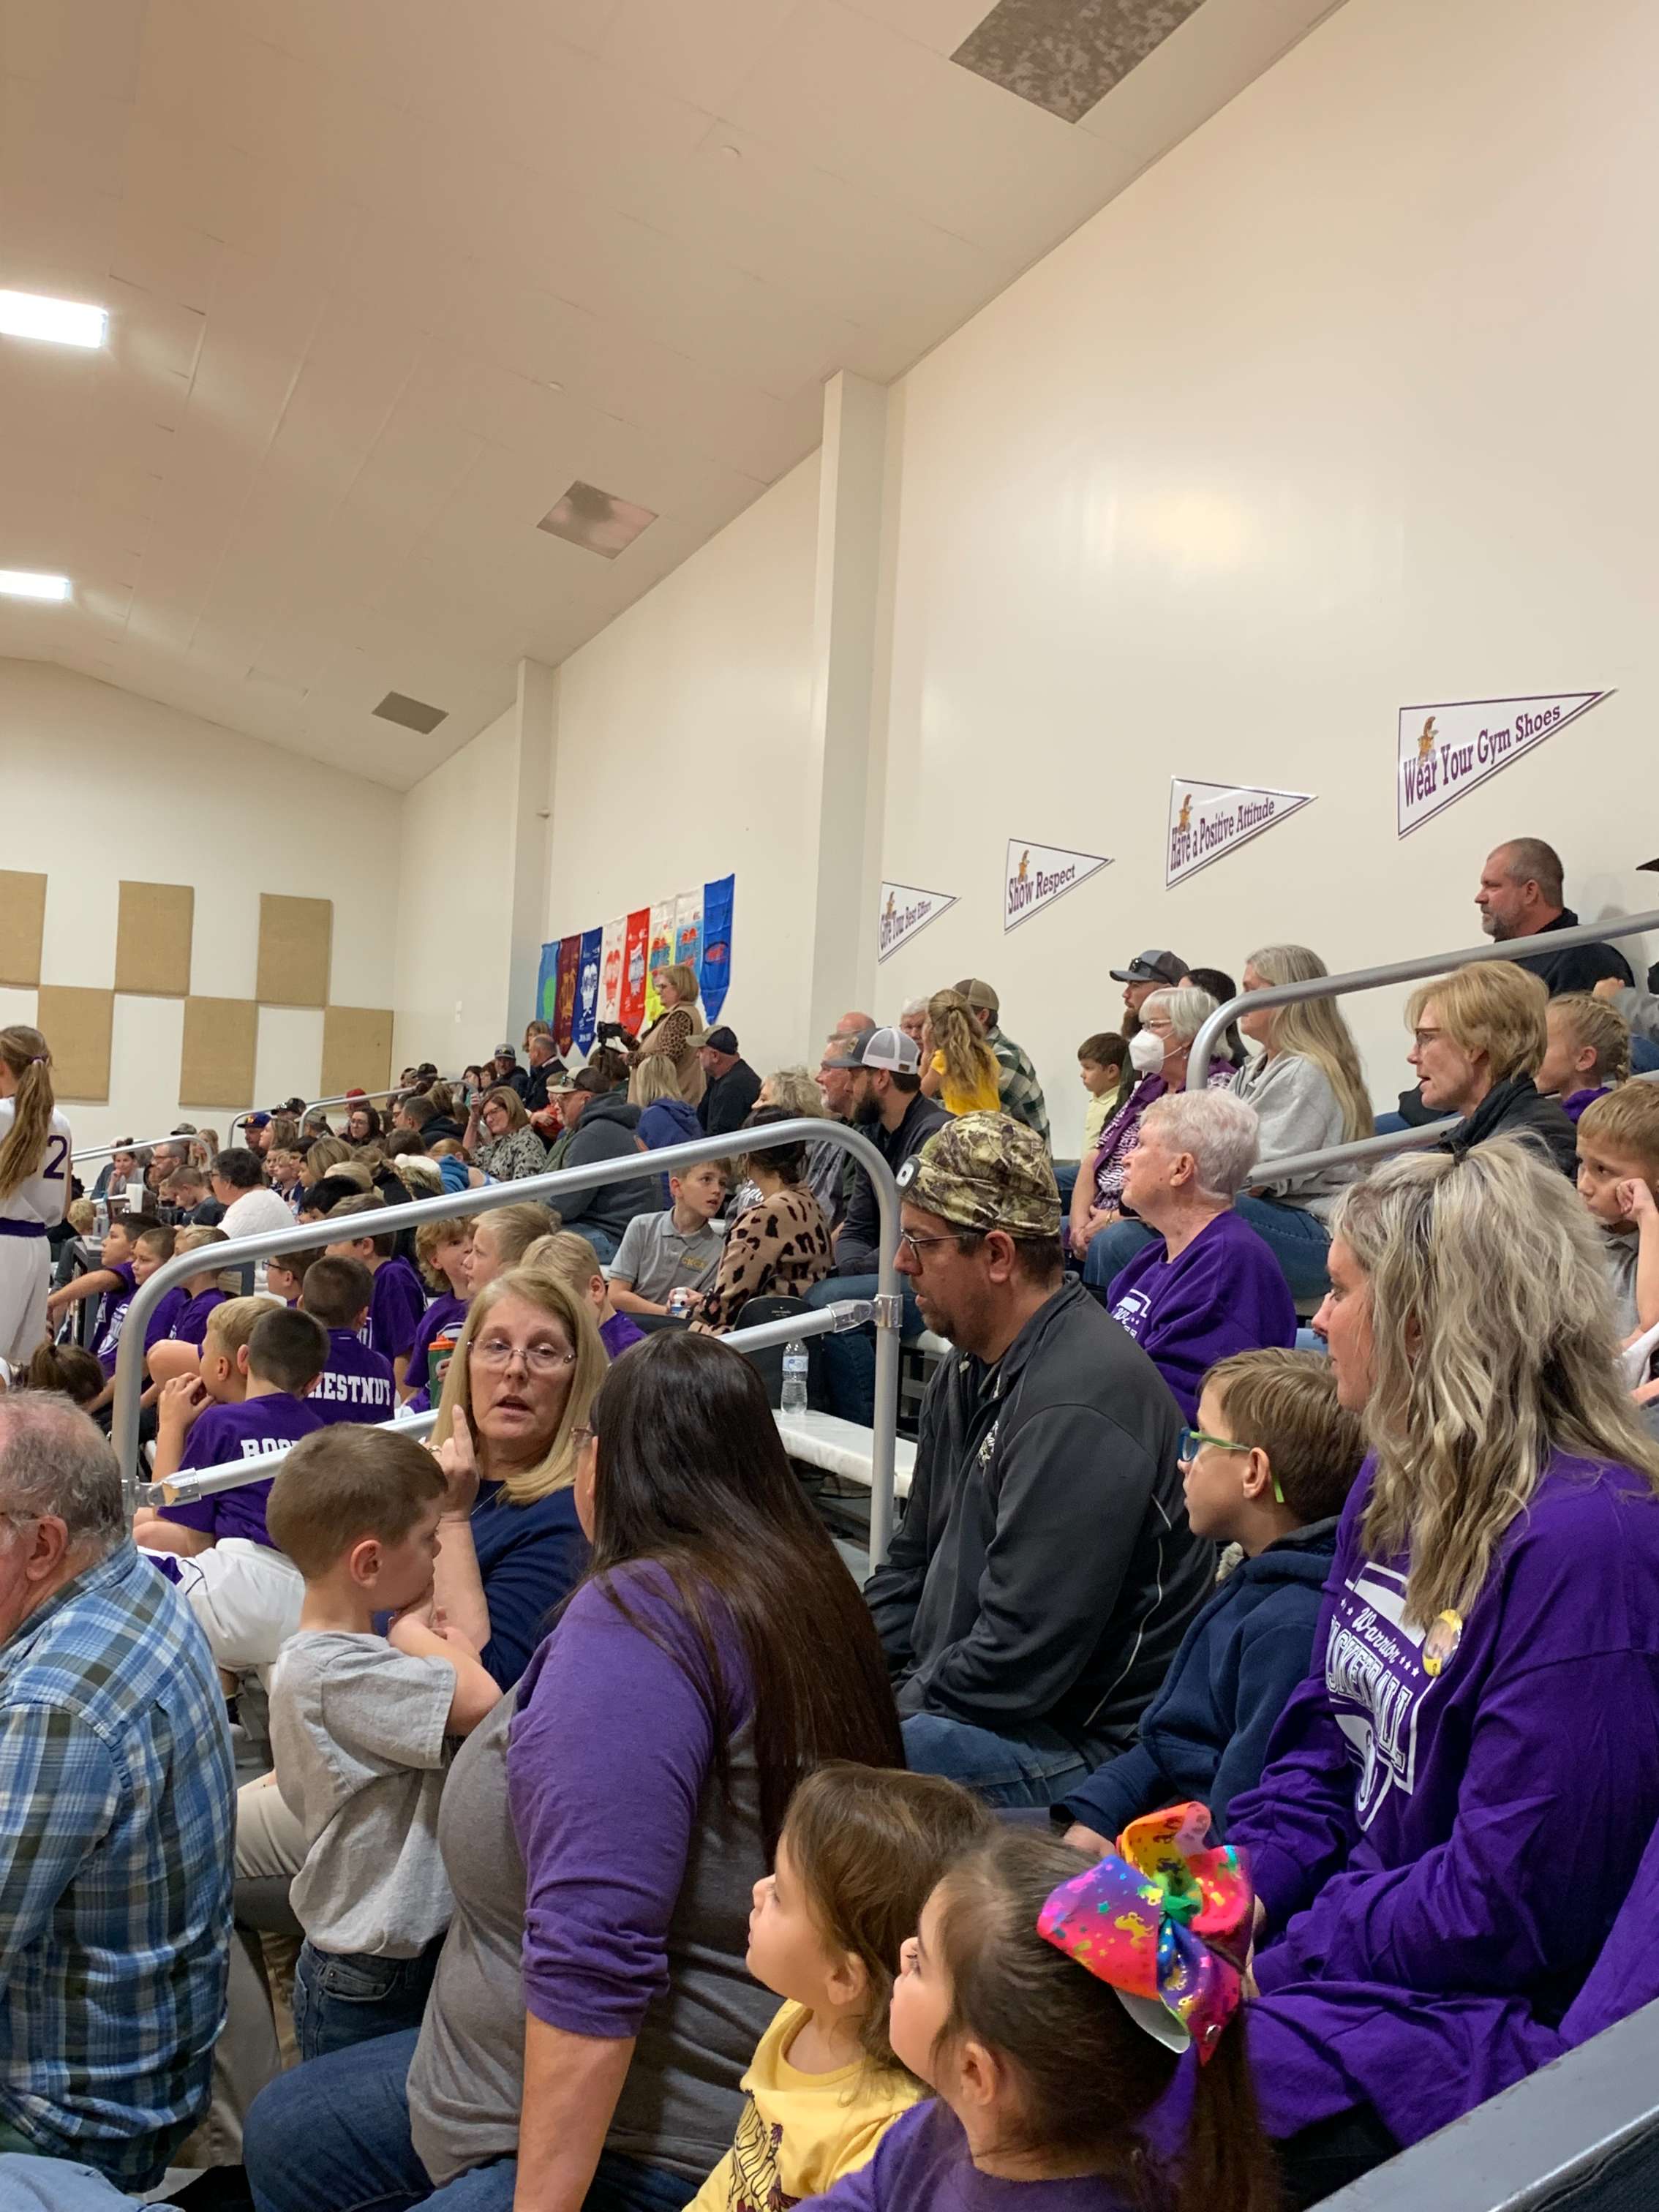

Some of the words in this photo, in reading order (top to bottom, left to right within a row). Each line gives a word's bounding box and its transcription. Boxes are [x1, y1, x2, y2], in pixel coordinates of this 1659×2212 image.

[1404, 756, 1437, 808] Wear
[1440, 743, 1474, 786] Your
[1477, 729, 1511, 764] Gym
[1515, 705, 1560, 743] Shoes
[1170, 827, 1191, 871] Have
[1192, 829, 1198, 858] a
[1199, 812, 1234, 854] Positive
[1235, 797, 1275, 832] Attitude
[1008, 877, 1034, 914] Show
[1035, 863, 1075, 900] Respect
[42, 1135, 67, 1180] 2
[1352, 1606, 1400, 1664] Warrior
